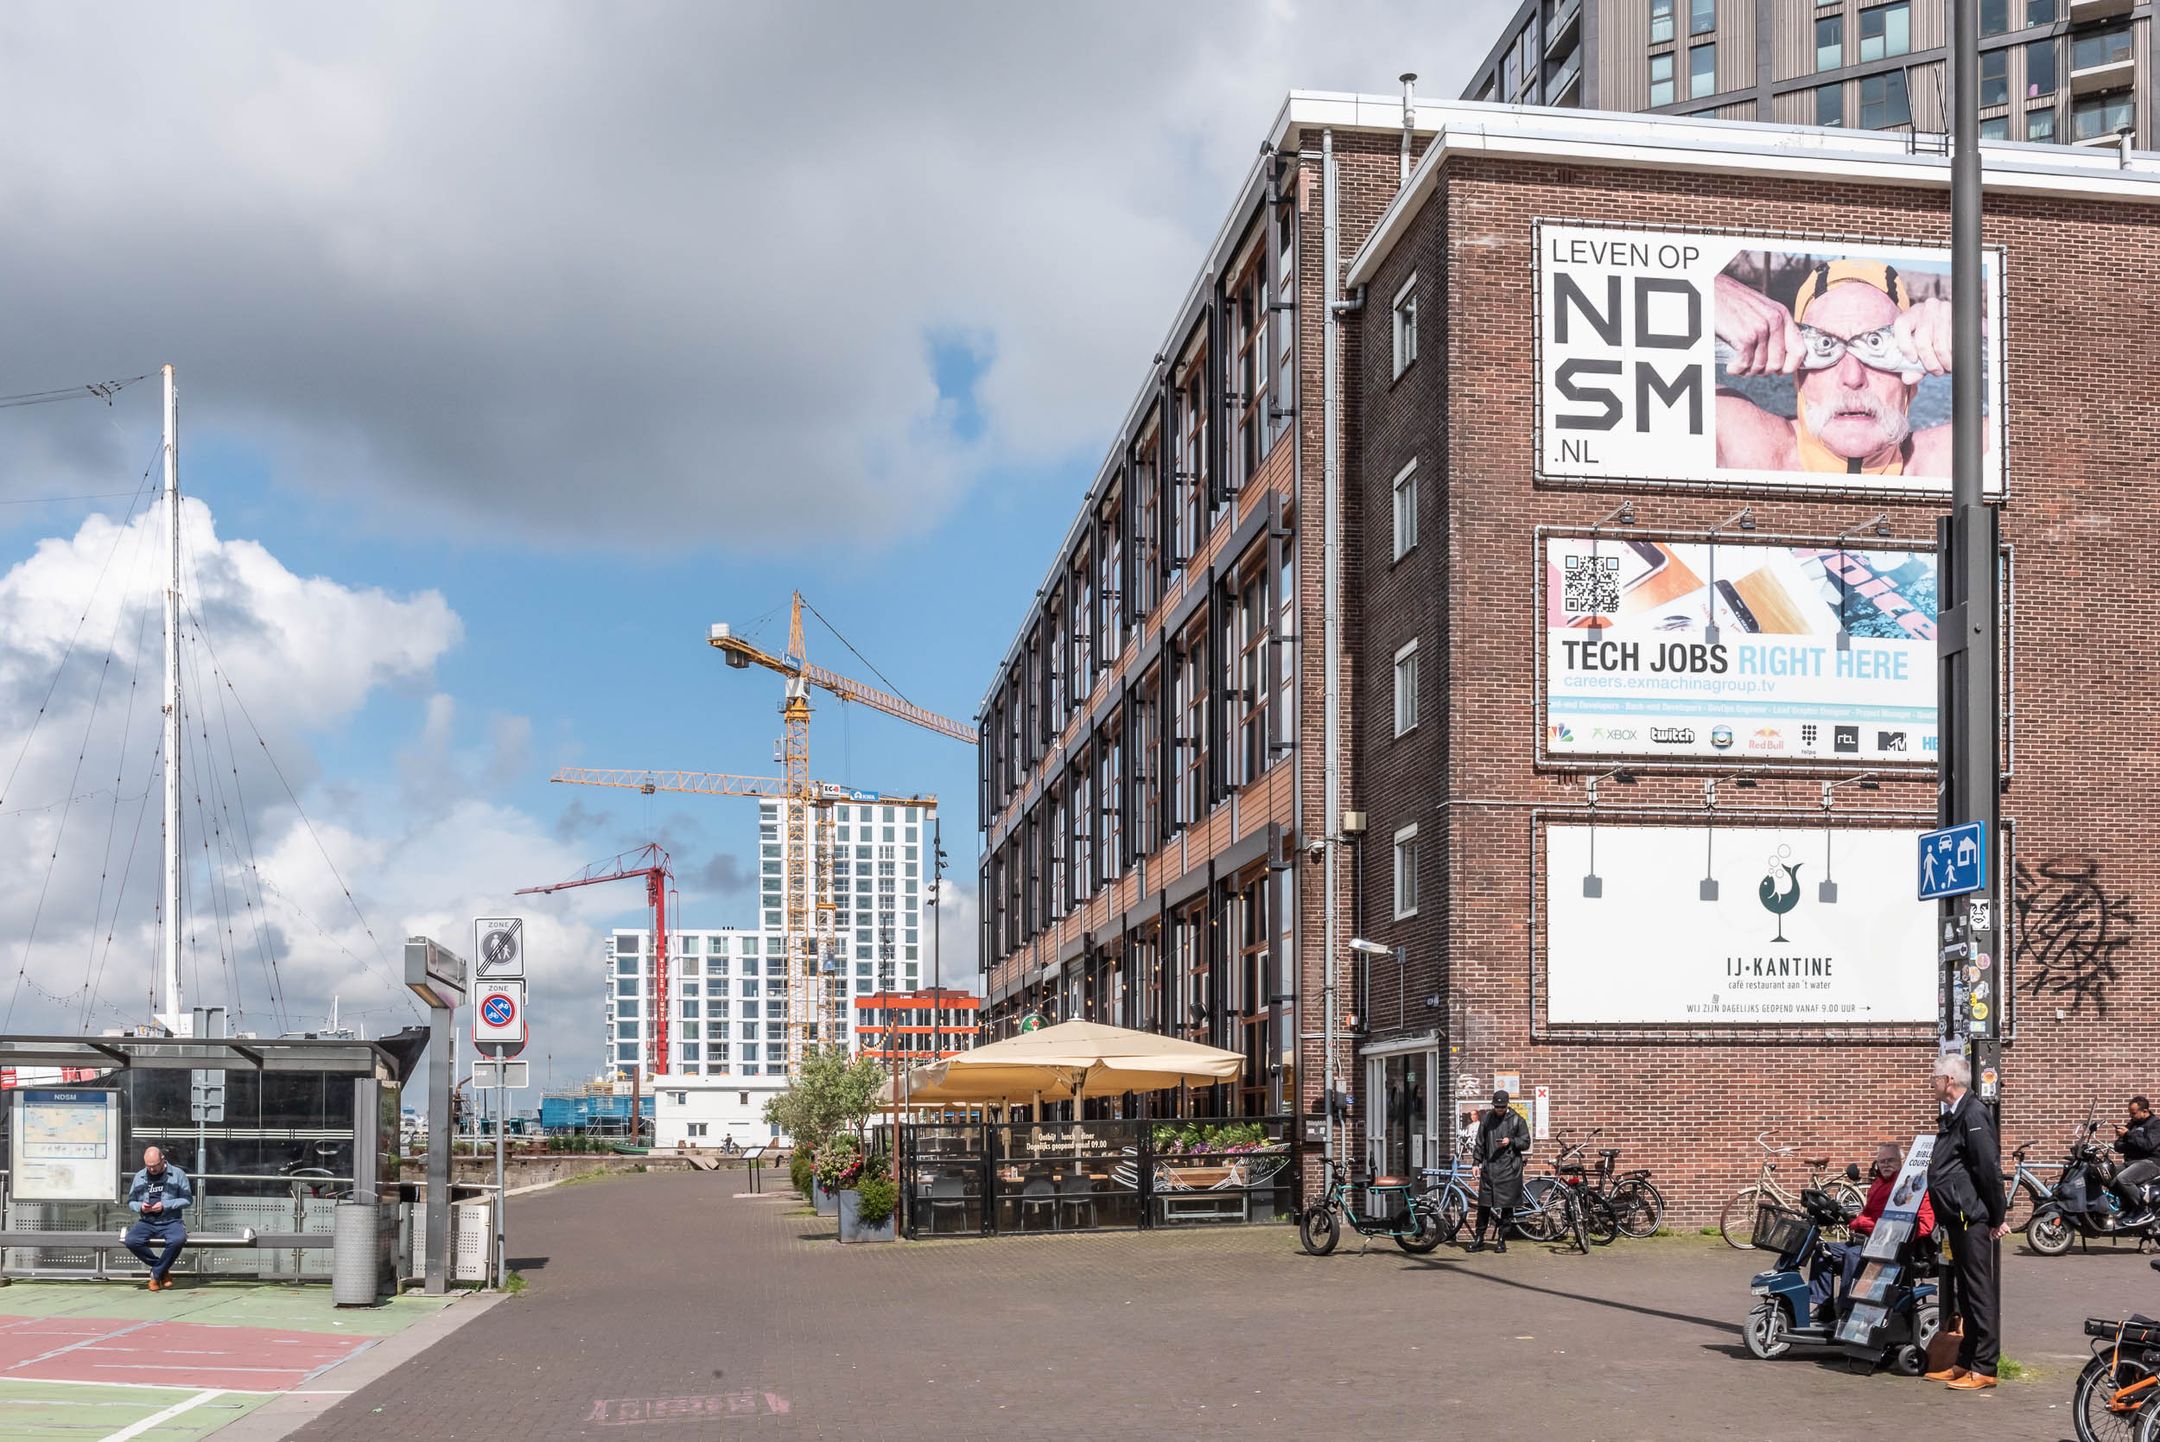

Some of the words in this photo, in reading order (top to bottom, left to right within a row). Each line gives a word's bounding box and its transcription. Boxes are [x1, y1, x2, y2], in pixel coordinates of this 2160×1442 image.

[1553, 239, 1649, 267] LEVEN
[1658, 244, 1700, 269] OP
[1554, 439, 1599, 463] .NL
[1562, 640, 1639, 671] TECH
[1650, 643, 1728, 674] JOBS
[1739, 645, 1826, 677] RIGHT
[1836, 648, 1908, 680] HERE
[1564, 675, 1775, 694] careers.exmachinagroup.tv
[1607, 729, 1637, 741] XBOX
[1650, 727, 1695, 744] twitch
[1877, 731, 1907, 752] MTV
[1749, 739, 1767, 750] Red
[1767, 740, 1784, 751] Bull
[1922, 736, 1938, 751] HB
[1746, 980, 1785, 989] restaurant
[1810, 981, 1831, 989] water
[1686, 1004, 1701, 1013] WIJ
[1702, 1004, 1719, 1013] ZIJN
[1722, 1004, 1759, 1013] DAGELIJKS
[1762, 1004, 1793, 1013] GEOPEND
[1796, 1004, 1818, 1013] VANAF
[1821, 1004, 1839, 1013] 9.00
[1841, 1004, 1856, 1013] UUR
[1061, 1132, 1076, 1140] lunch
[1026, 1142, 1051, 1151] Dagelijks
[1051, 1141, 1075, 1151] geopend
[1090, 1140, 1107, 1149] 09.00
[1908, 1159, 1930, 1167] COURS
